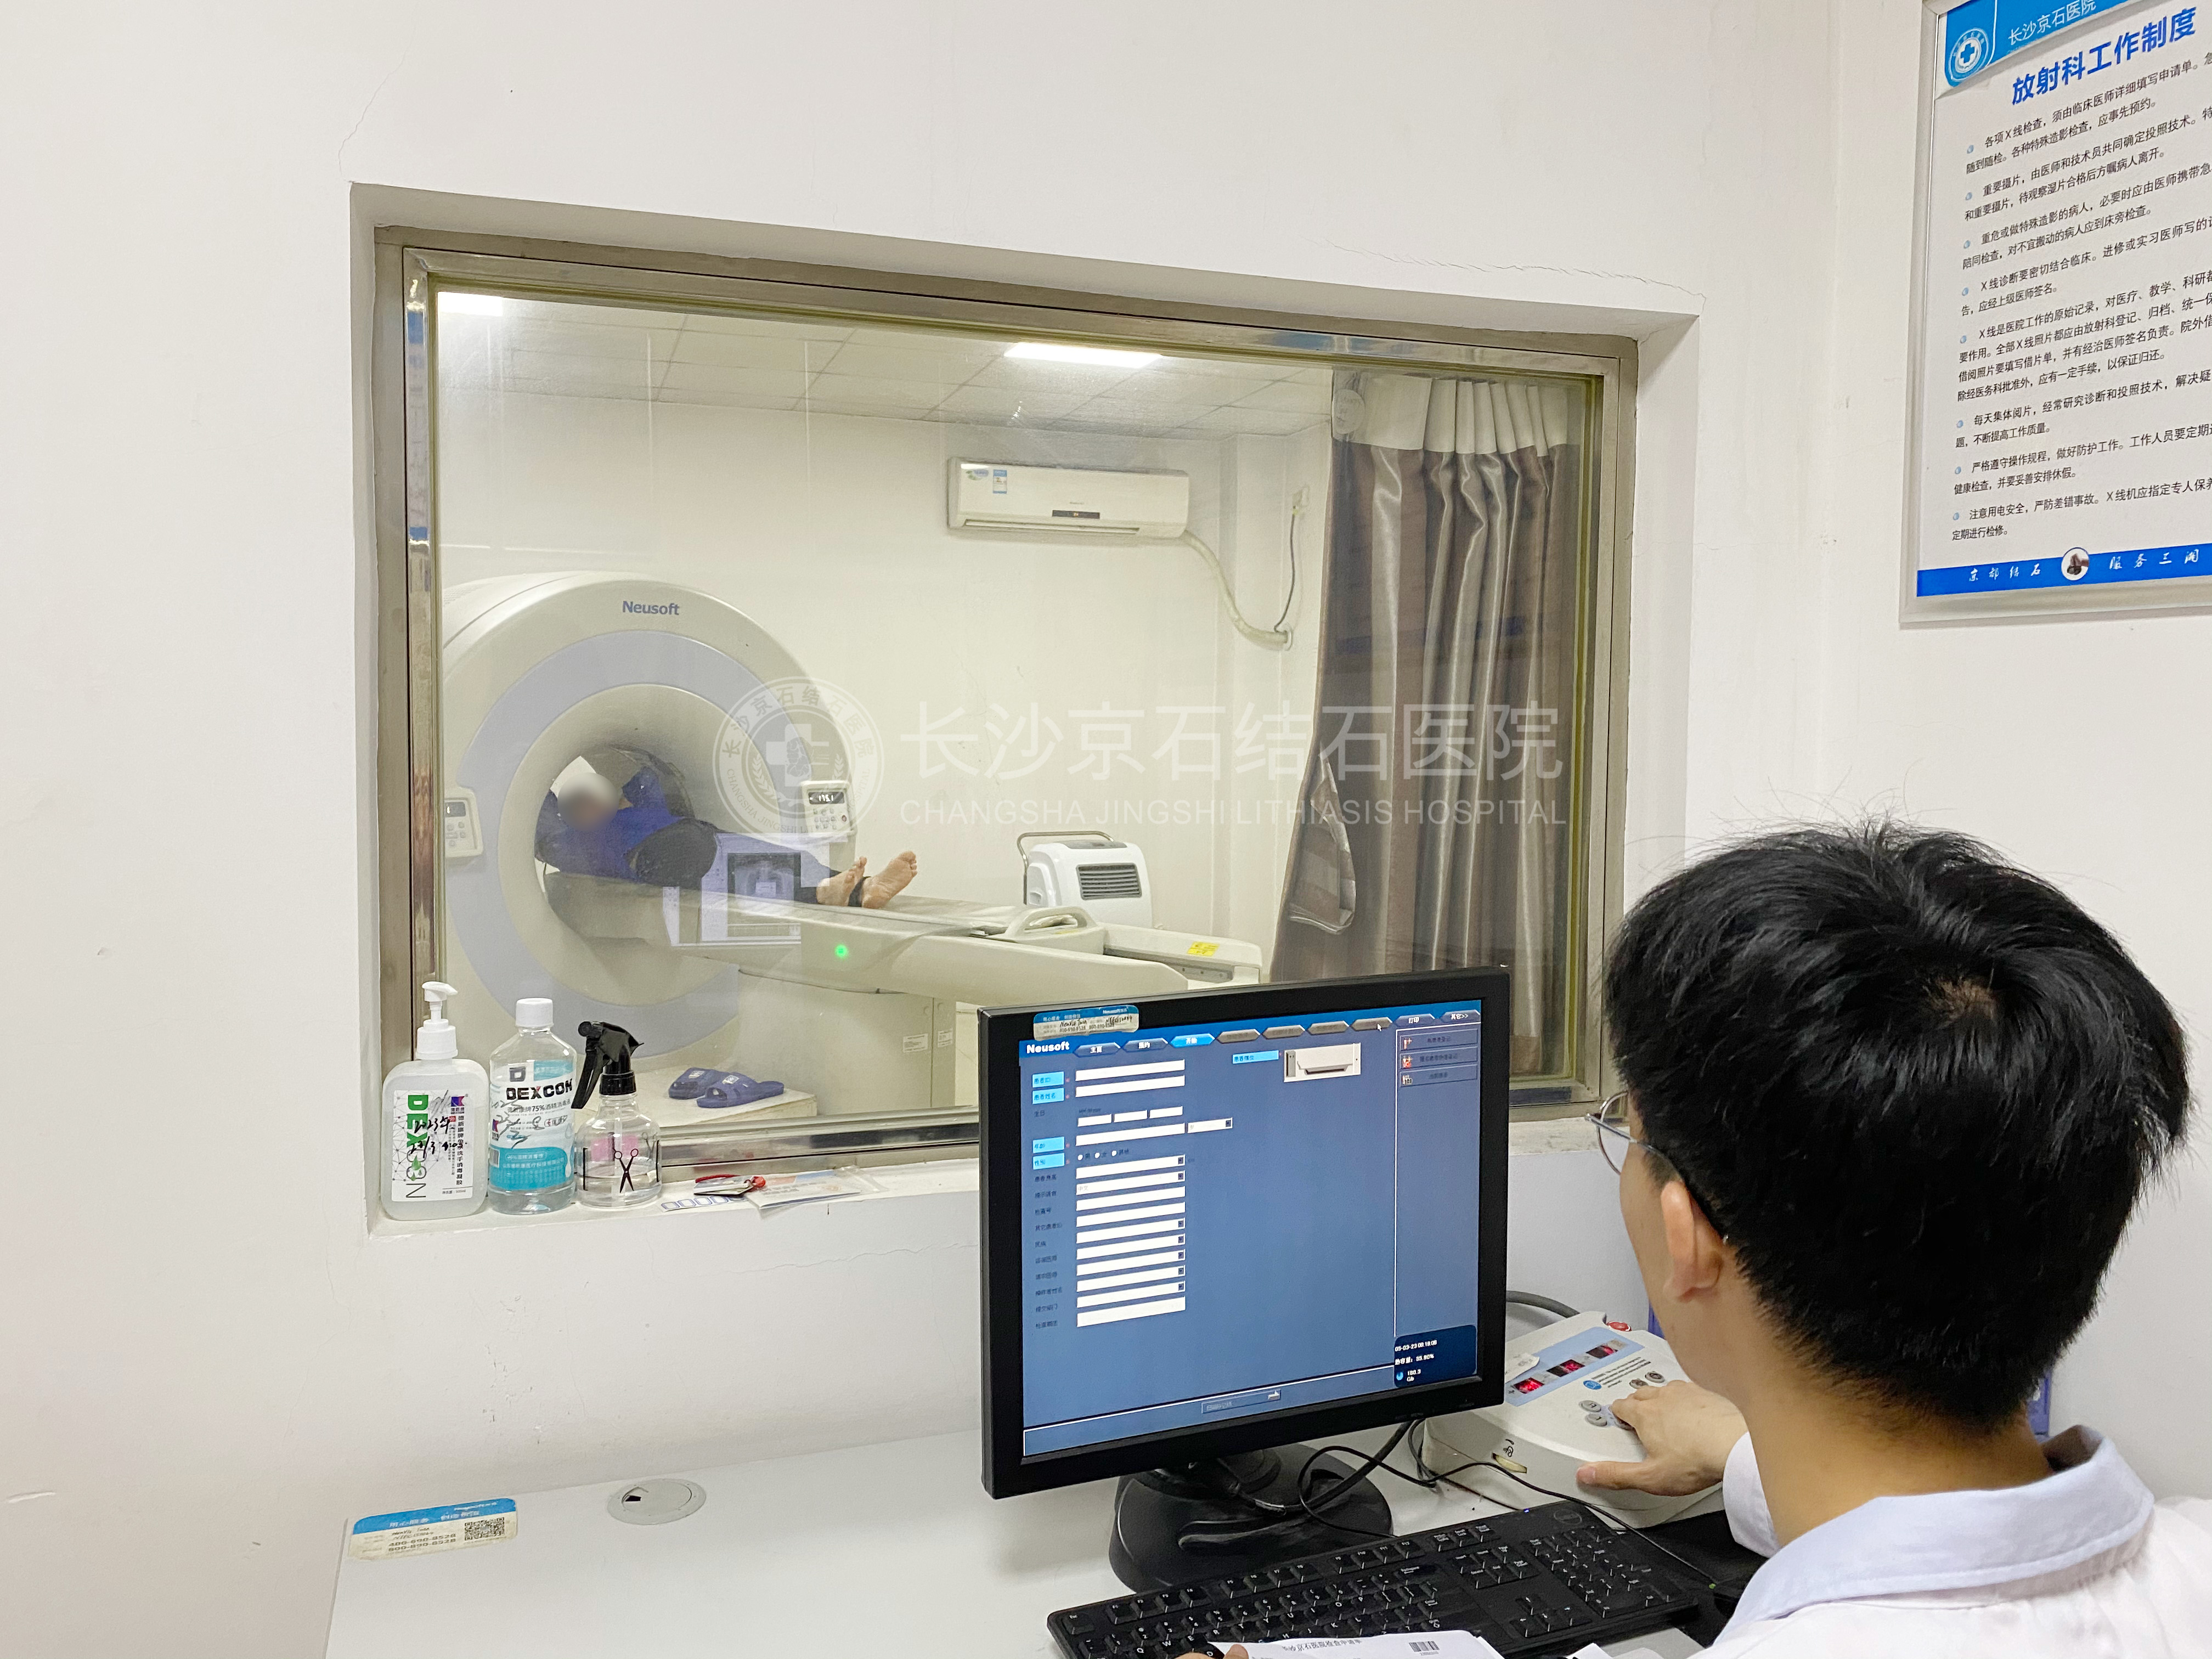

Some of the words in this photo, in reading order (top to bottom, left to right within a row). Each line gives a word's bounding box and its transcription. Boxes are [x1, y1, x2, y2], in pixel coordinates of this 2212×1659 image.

[2008, 0, 2096, 46] 长沙京石医院
[2012, 7, 2197, 105] 放射科工作制度
[1961, 282, 2058, 317] 告，应经上级医师签名。
[1955, 422, 2051, 448] 题，不断提高工作质量。
[1952, 525, 2008, 541] 定期进行检修。
[622, 601, 680, 615] Neusoft
[1026, 1041, 1070, 1054] Neusoft
[506, 1079, 573, 1101] DEXCON
[406, 1094, 429, 1198] DEXCON
